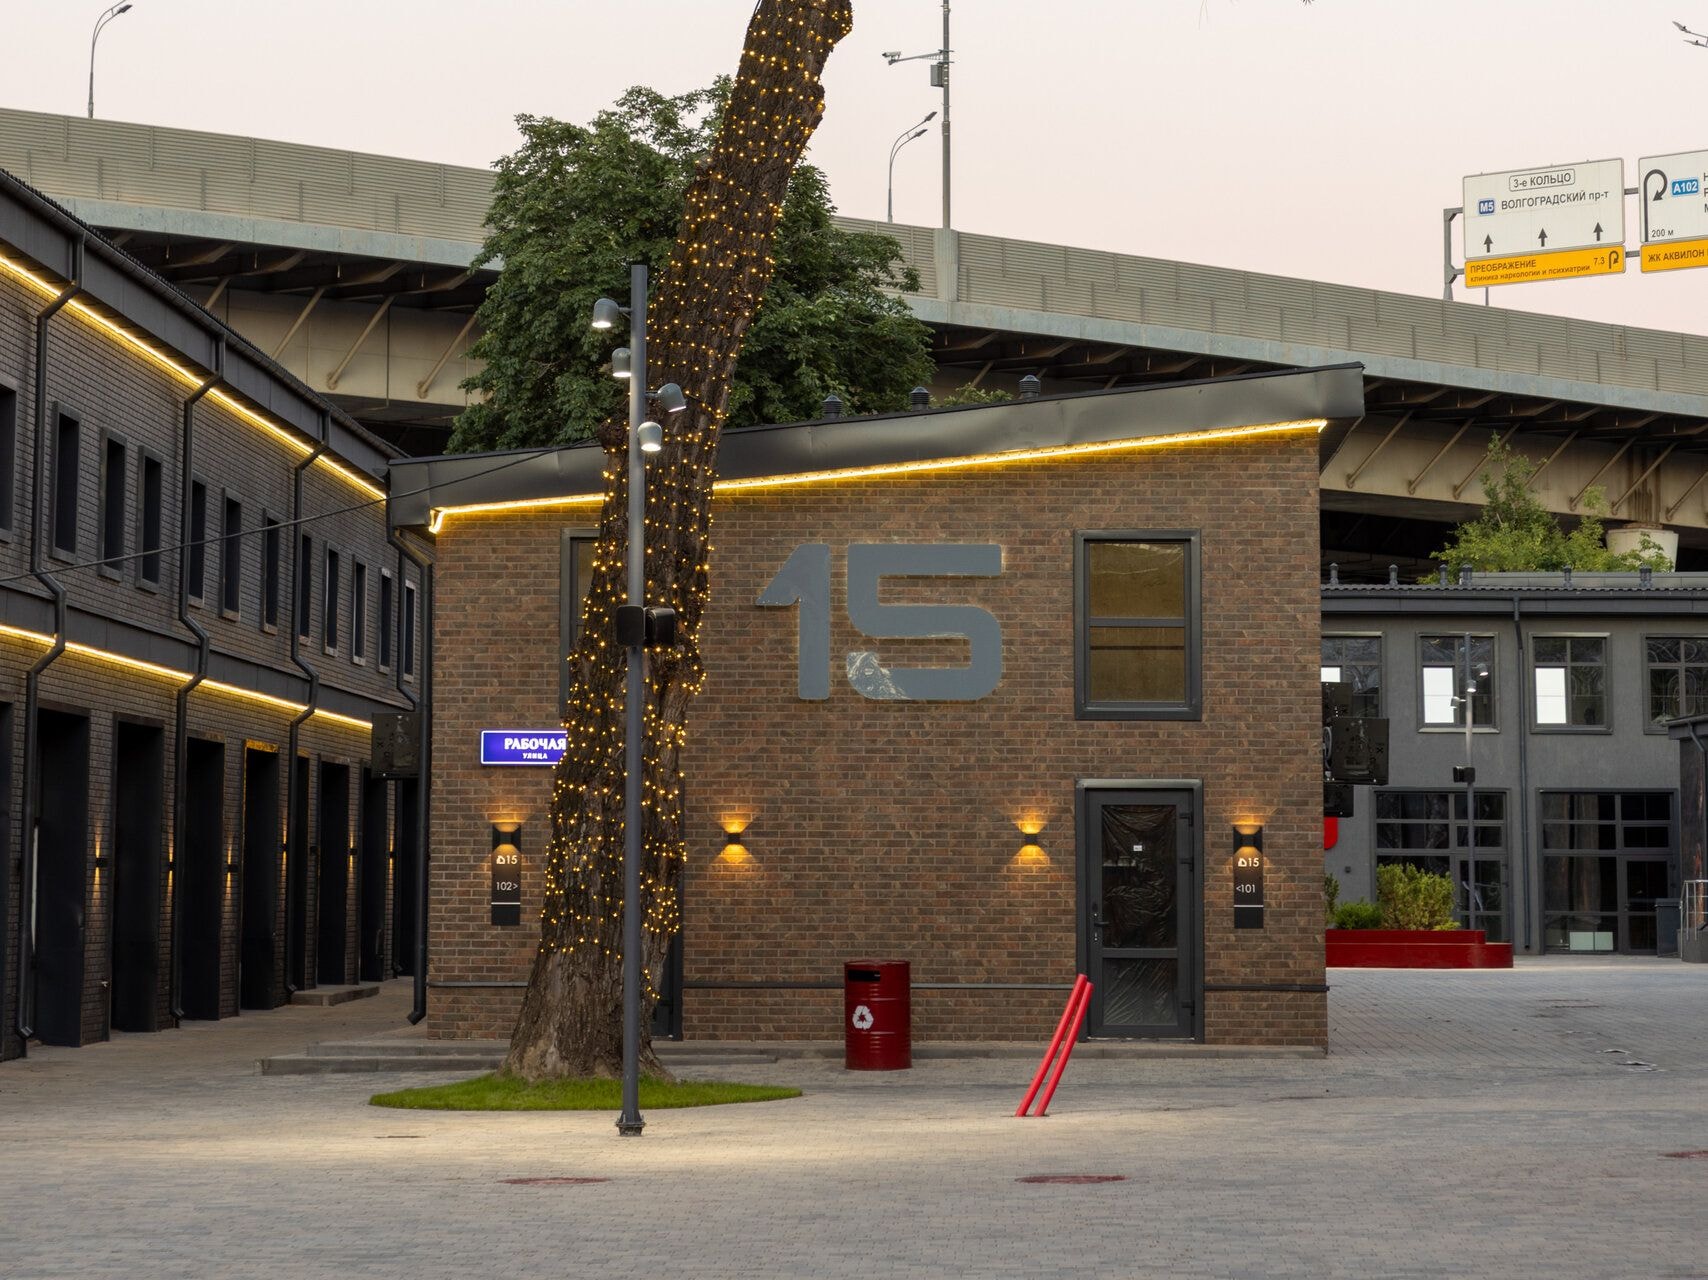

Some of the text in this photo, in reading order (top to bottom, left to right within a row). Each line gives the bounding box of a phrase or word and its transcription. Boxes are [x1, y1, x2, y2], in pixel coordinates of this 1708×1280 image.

[1513, 172, 1571, 188] 3-е КОЛЬЦО
[1501, 190, 1608, 210] ВОЛГОГРАДСКИЙ пр-т
[1651, 229, 1666, 237] 200
[1594, 257, 1605, 266] 7.3
[1648, 253, 1661, 262] ЖК
[1663, 249, 1704, 261] АКВИЛОН
[1470, 259, 1536, 273] ПРЕОБРАЖЕНИЕ
[1470, 274, 1498, 282] клиника
[1500, 270, 1541, 280] наркологии
[1549, 265, 1591, 275] психиатрии
[755, 543, 1003, 700] 15
[504, 737, 567, 750] РАБОЧАЯ
